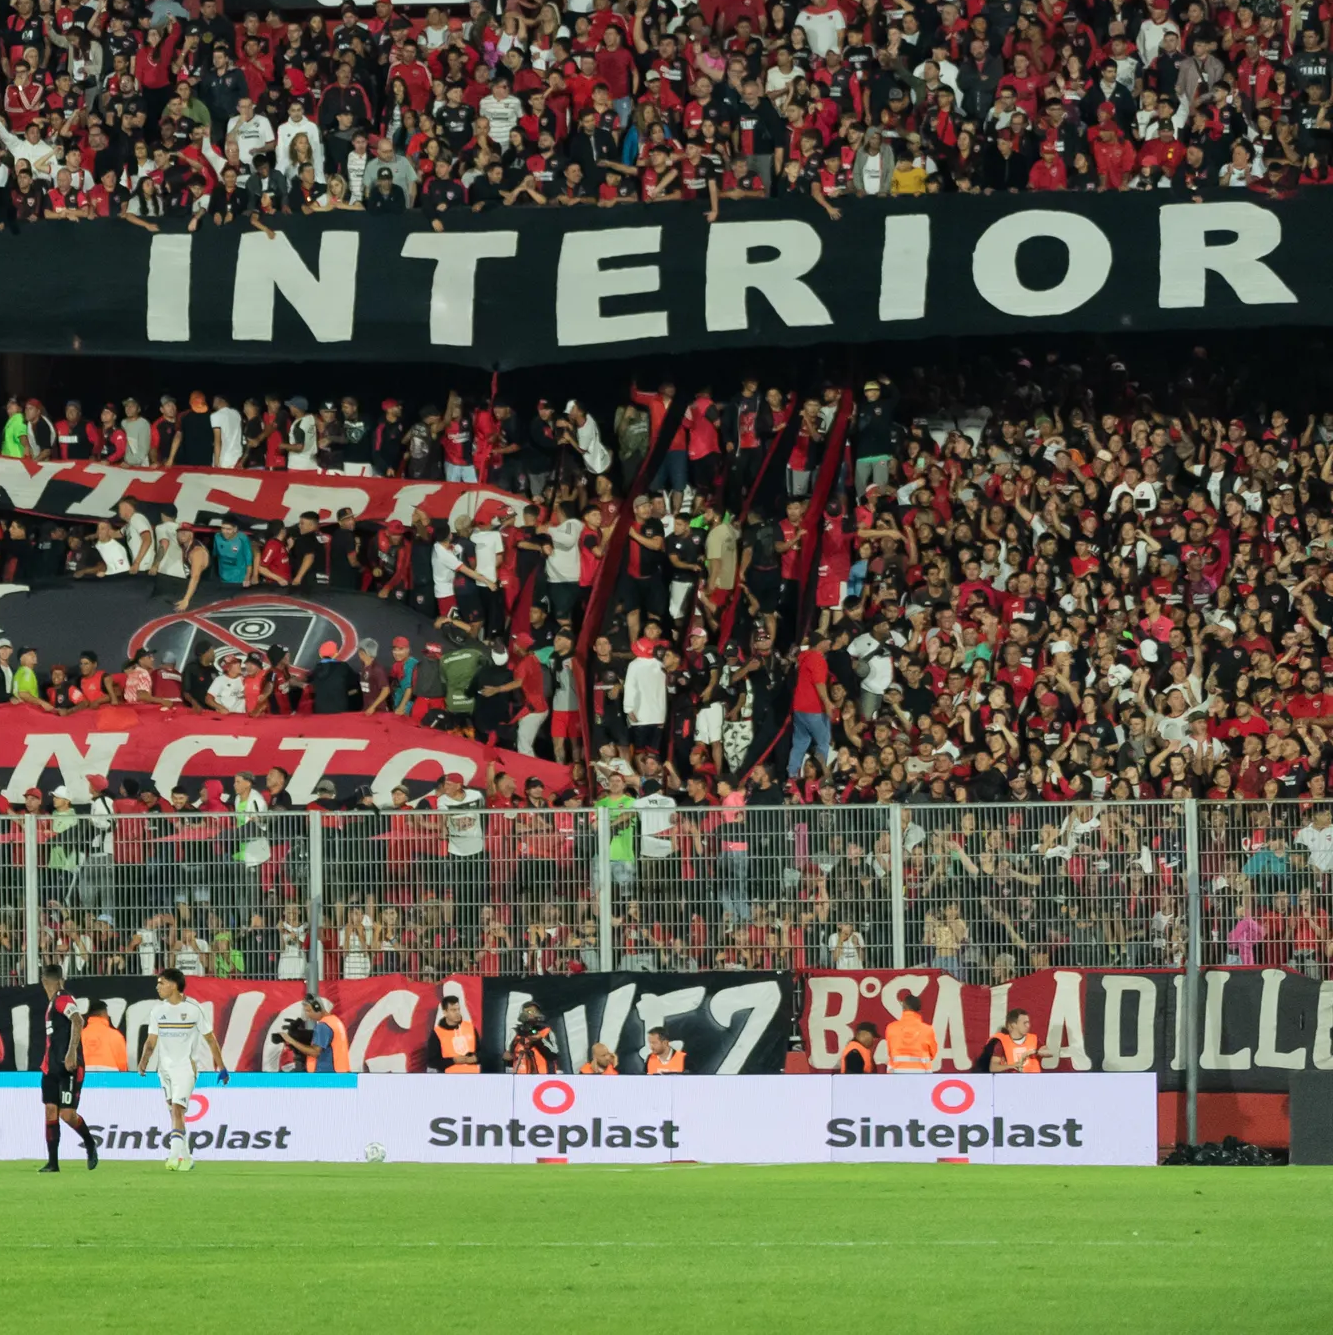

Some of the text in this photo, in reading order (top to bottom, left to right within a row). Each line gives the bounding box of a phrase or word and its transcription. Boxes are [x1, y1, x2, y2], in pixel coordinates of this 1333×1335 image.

[145, 201, 1299, 348] INTERIOR
[61, 1091, 72, 1104] 10
[78, 1125, 291, 1154] Sintplast
[428, 1116, 679, 1153] Sinteplast
[825, 1116, 1083, 1154] Sinteplast
